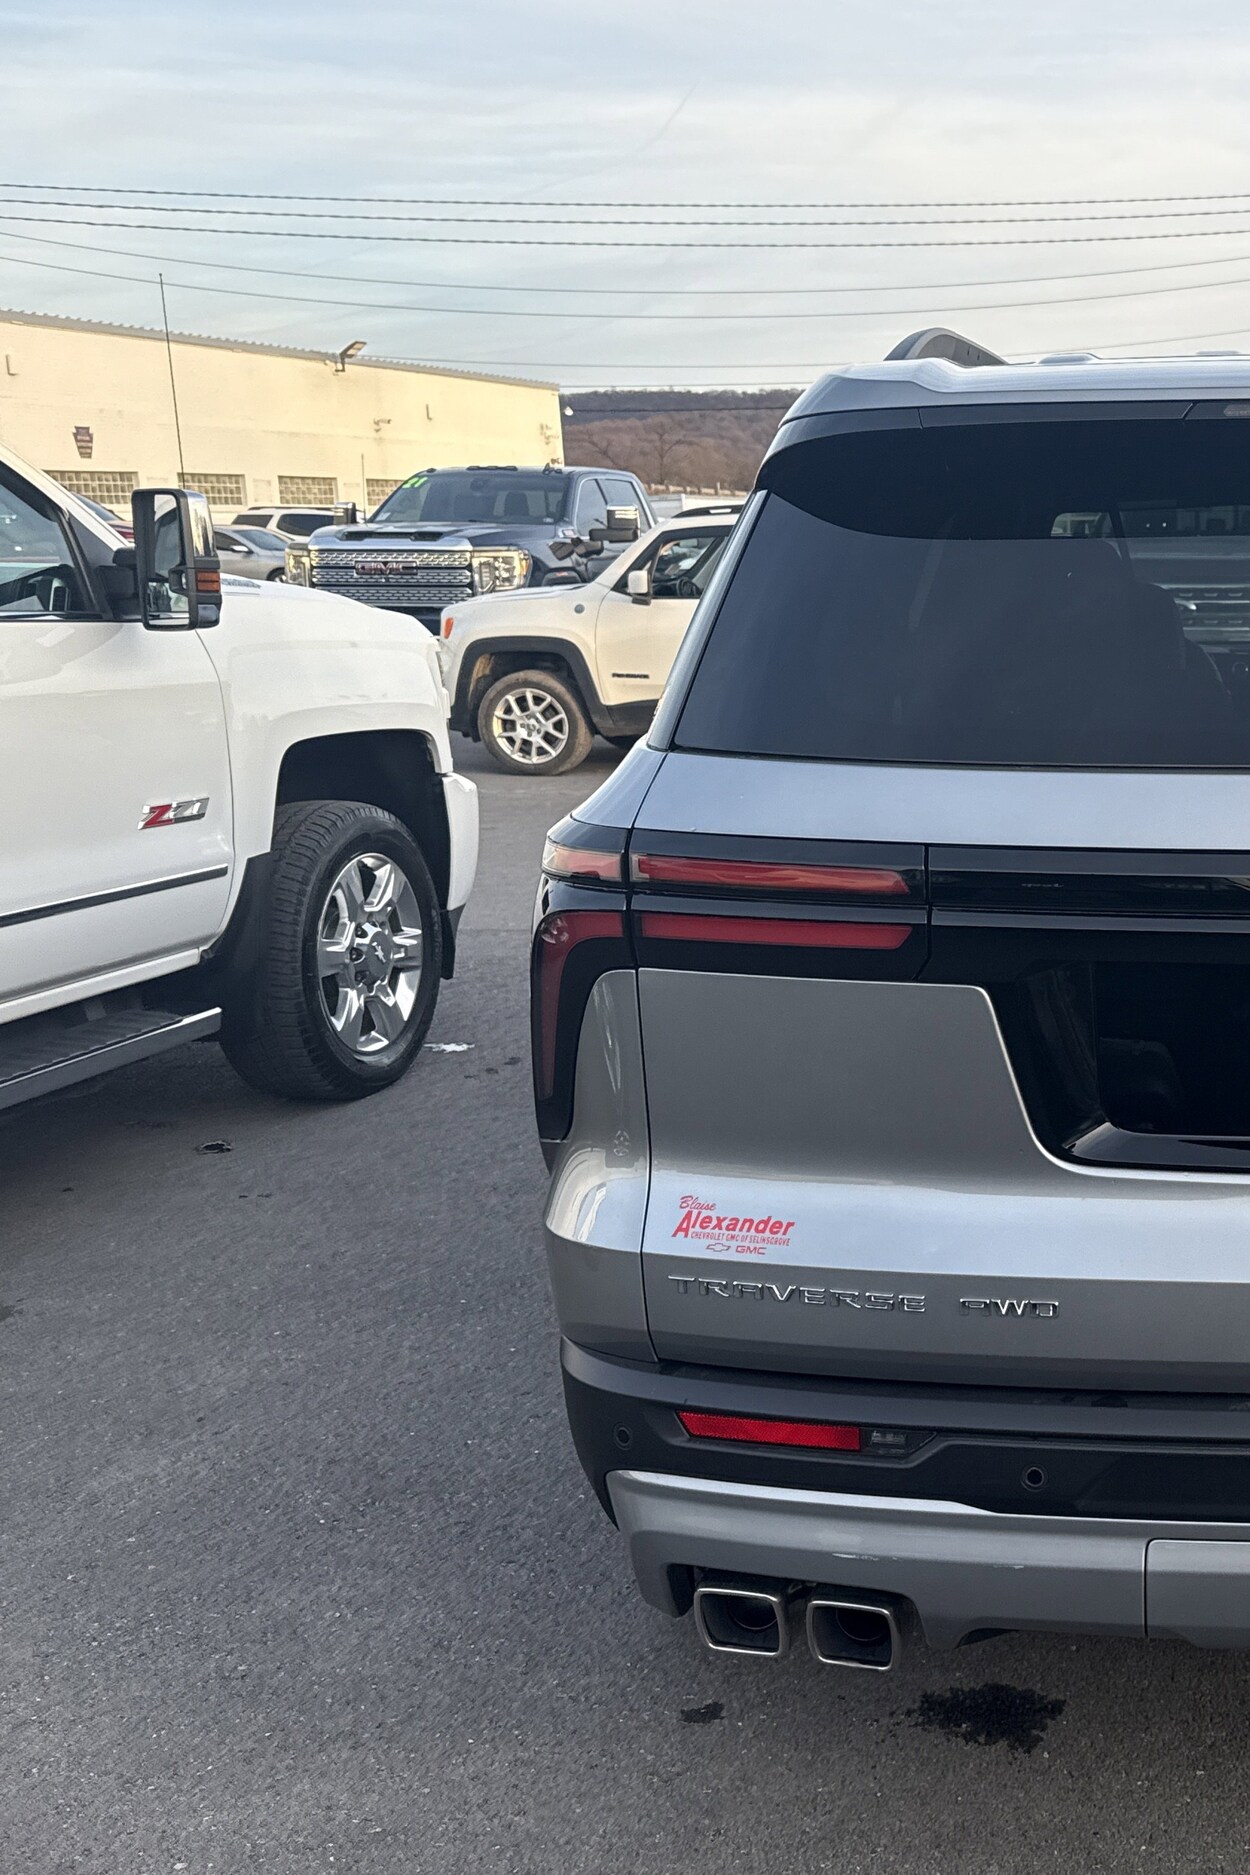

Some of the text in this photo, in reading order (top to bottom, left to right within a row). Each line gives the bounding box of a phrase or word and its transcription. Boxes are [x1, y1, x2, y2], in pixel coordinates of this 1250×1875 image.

[355, 561, 418, 576] GMC
[137, 797, 209, 830] Z71
[679, 1195, 717, 1211] Blaise
[671, 1210, 796, 1238] Alexander
[690, 1231, 791, 1247] CHEVROLET GMC OF SELINSGROVE
[735, 1245, 767, 1255] GMC
[668, 1275, 1060, 1318] TRAVERSE AWD
